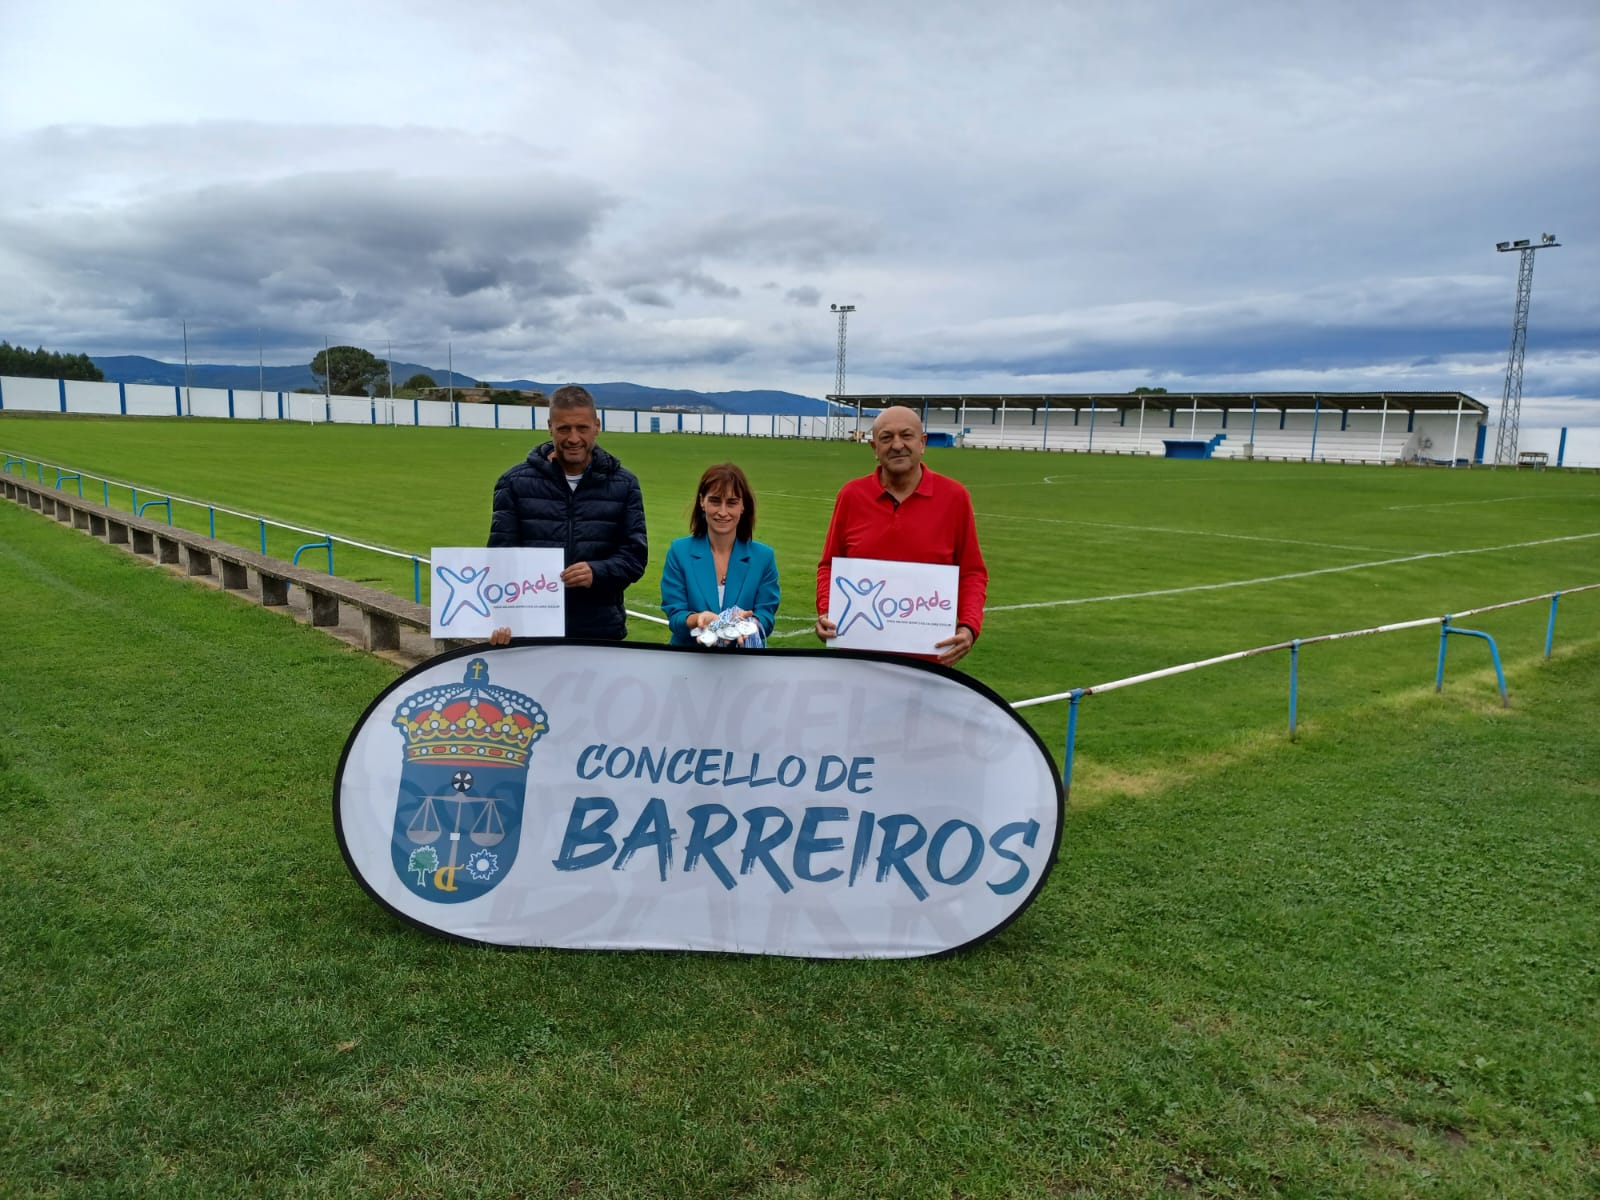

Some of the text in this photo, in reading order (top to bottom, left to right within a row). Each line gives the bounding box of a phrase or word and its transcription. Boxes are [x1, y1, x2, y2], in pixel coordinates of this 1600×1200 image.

[577, 744, 875, 793] CONCELLO DE
[552, 796, 1040, 902] BARREIROS
